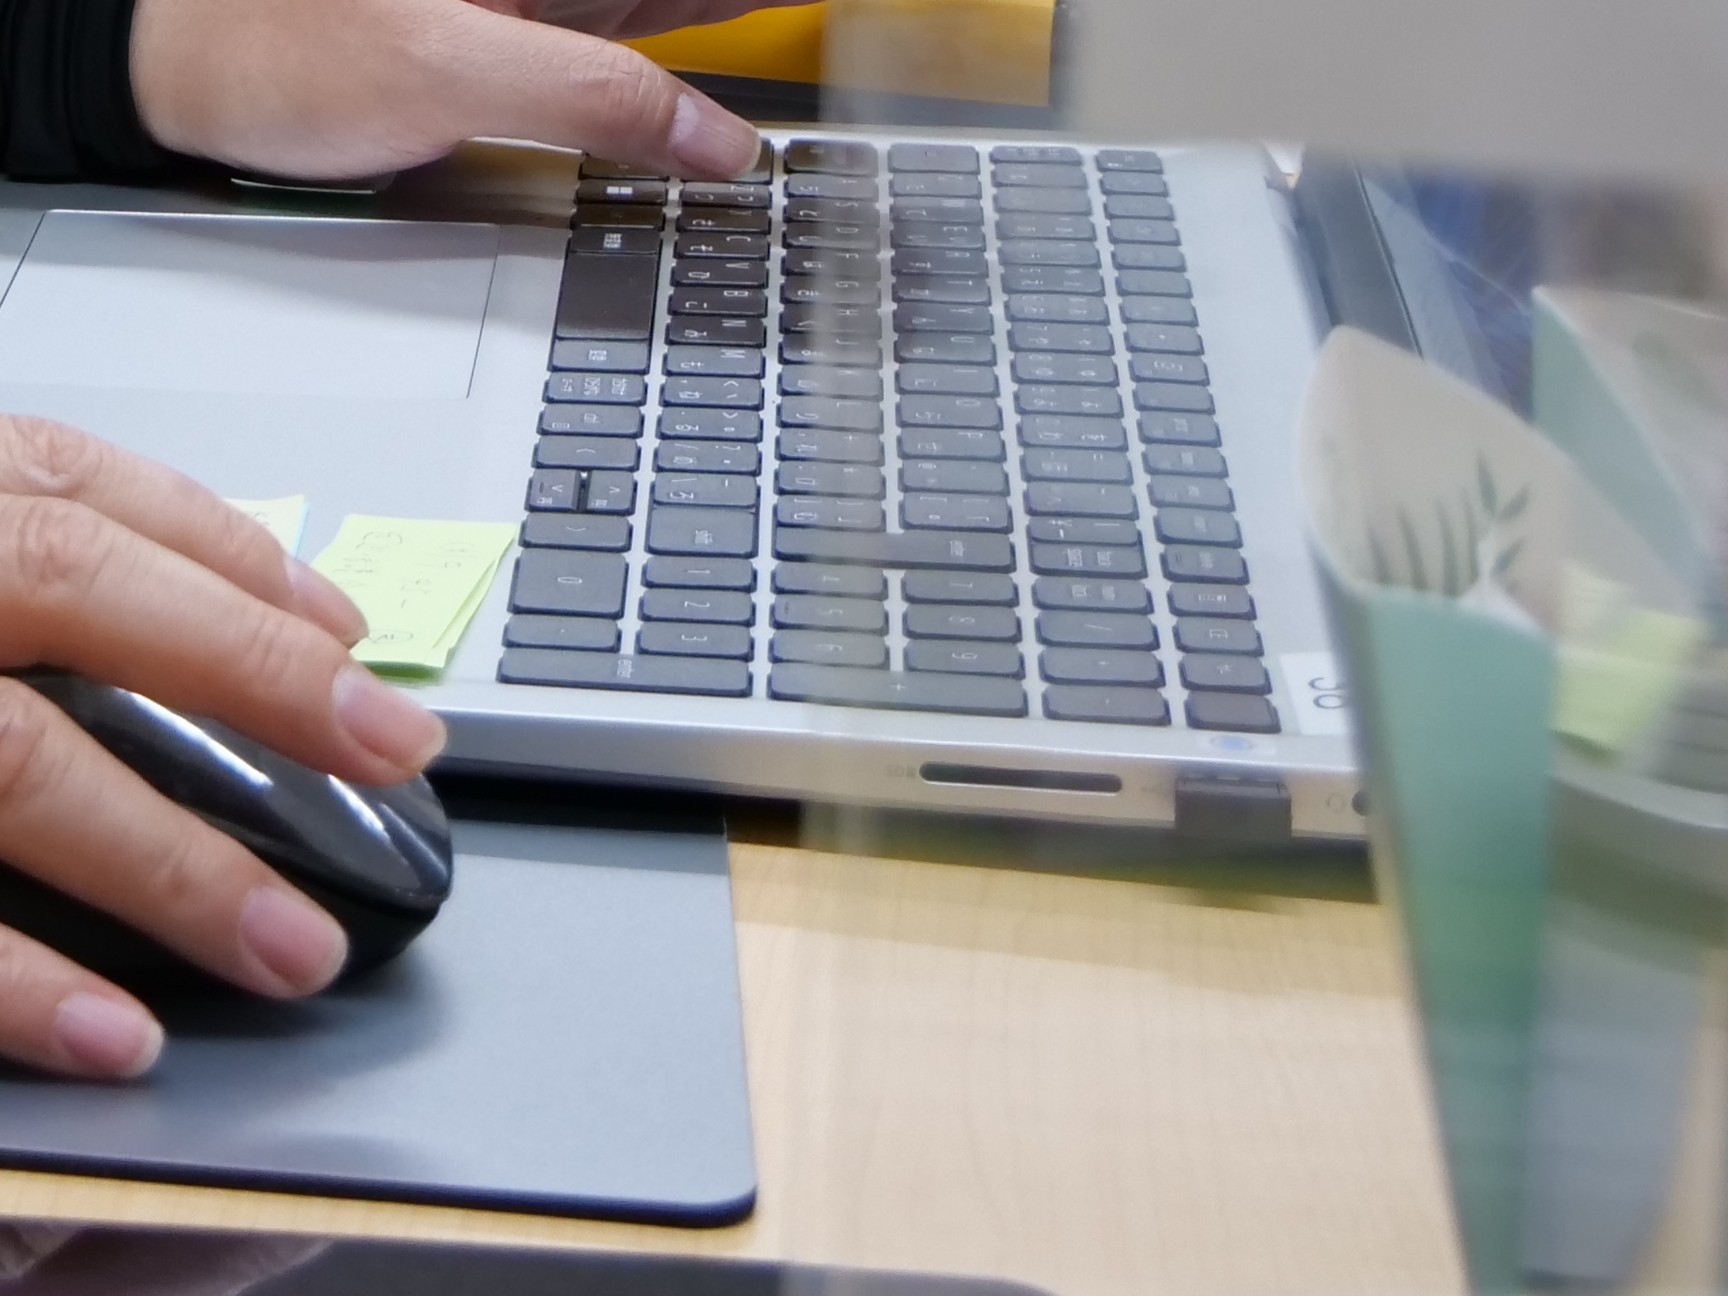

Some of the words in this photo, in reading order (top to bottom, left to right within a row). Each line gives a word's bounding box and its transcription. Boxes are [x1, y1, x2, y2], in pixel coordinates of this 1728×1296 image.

[723, 289, 750, 298] B
[721, 318, 748, 328] N
[719, 348, 747, 360] M
[556, 575, 584, 586] 0
[615, 657, 637, 680] enter
